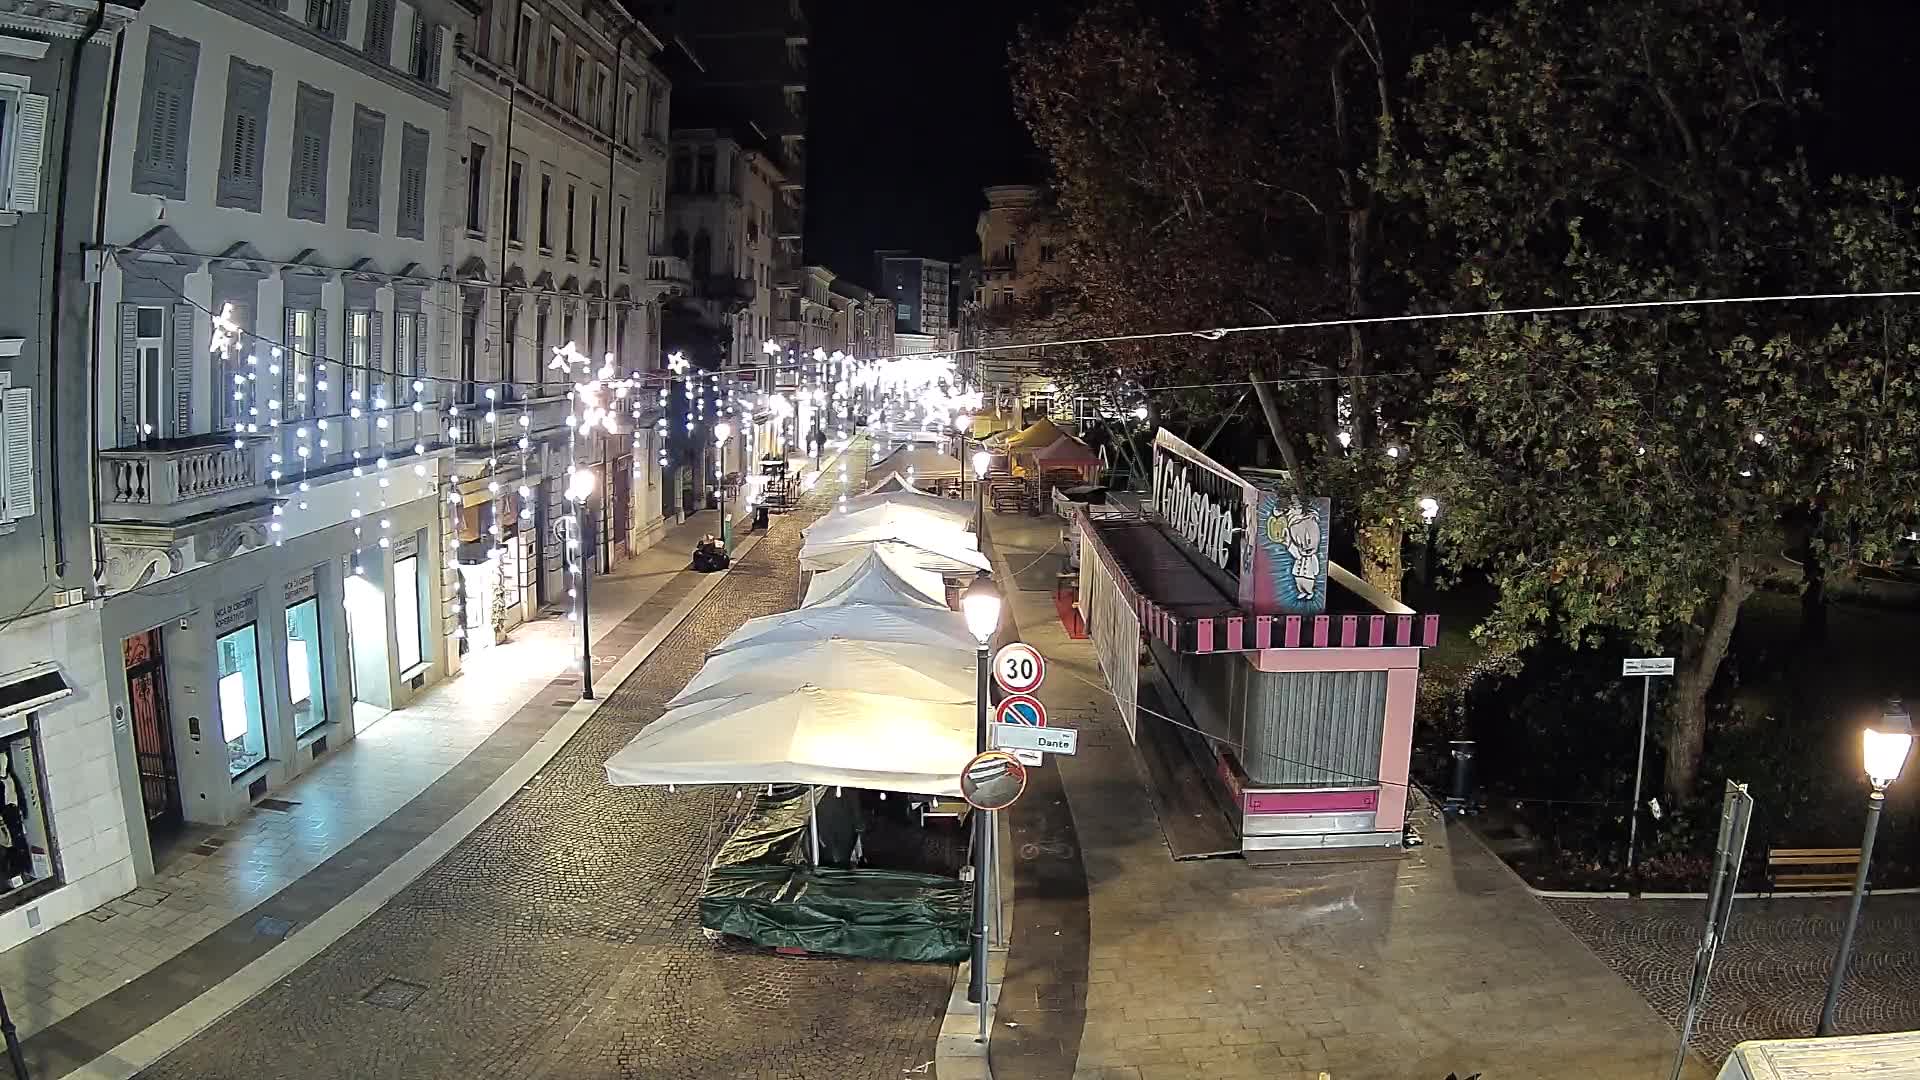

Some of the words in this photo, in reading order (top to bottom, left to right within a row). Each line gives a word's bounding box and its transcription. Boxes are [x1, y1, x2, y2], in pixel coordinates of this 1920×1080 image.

[1163, 458, 1233, 570] Golosone
[1006, 658, 1033, 680] 30
[1038, 737, 1070, 749] Dante
